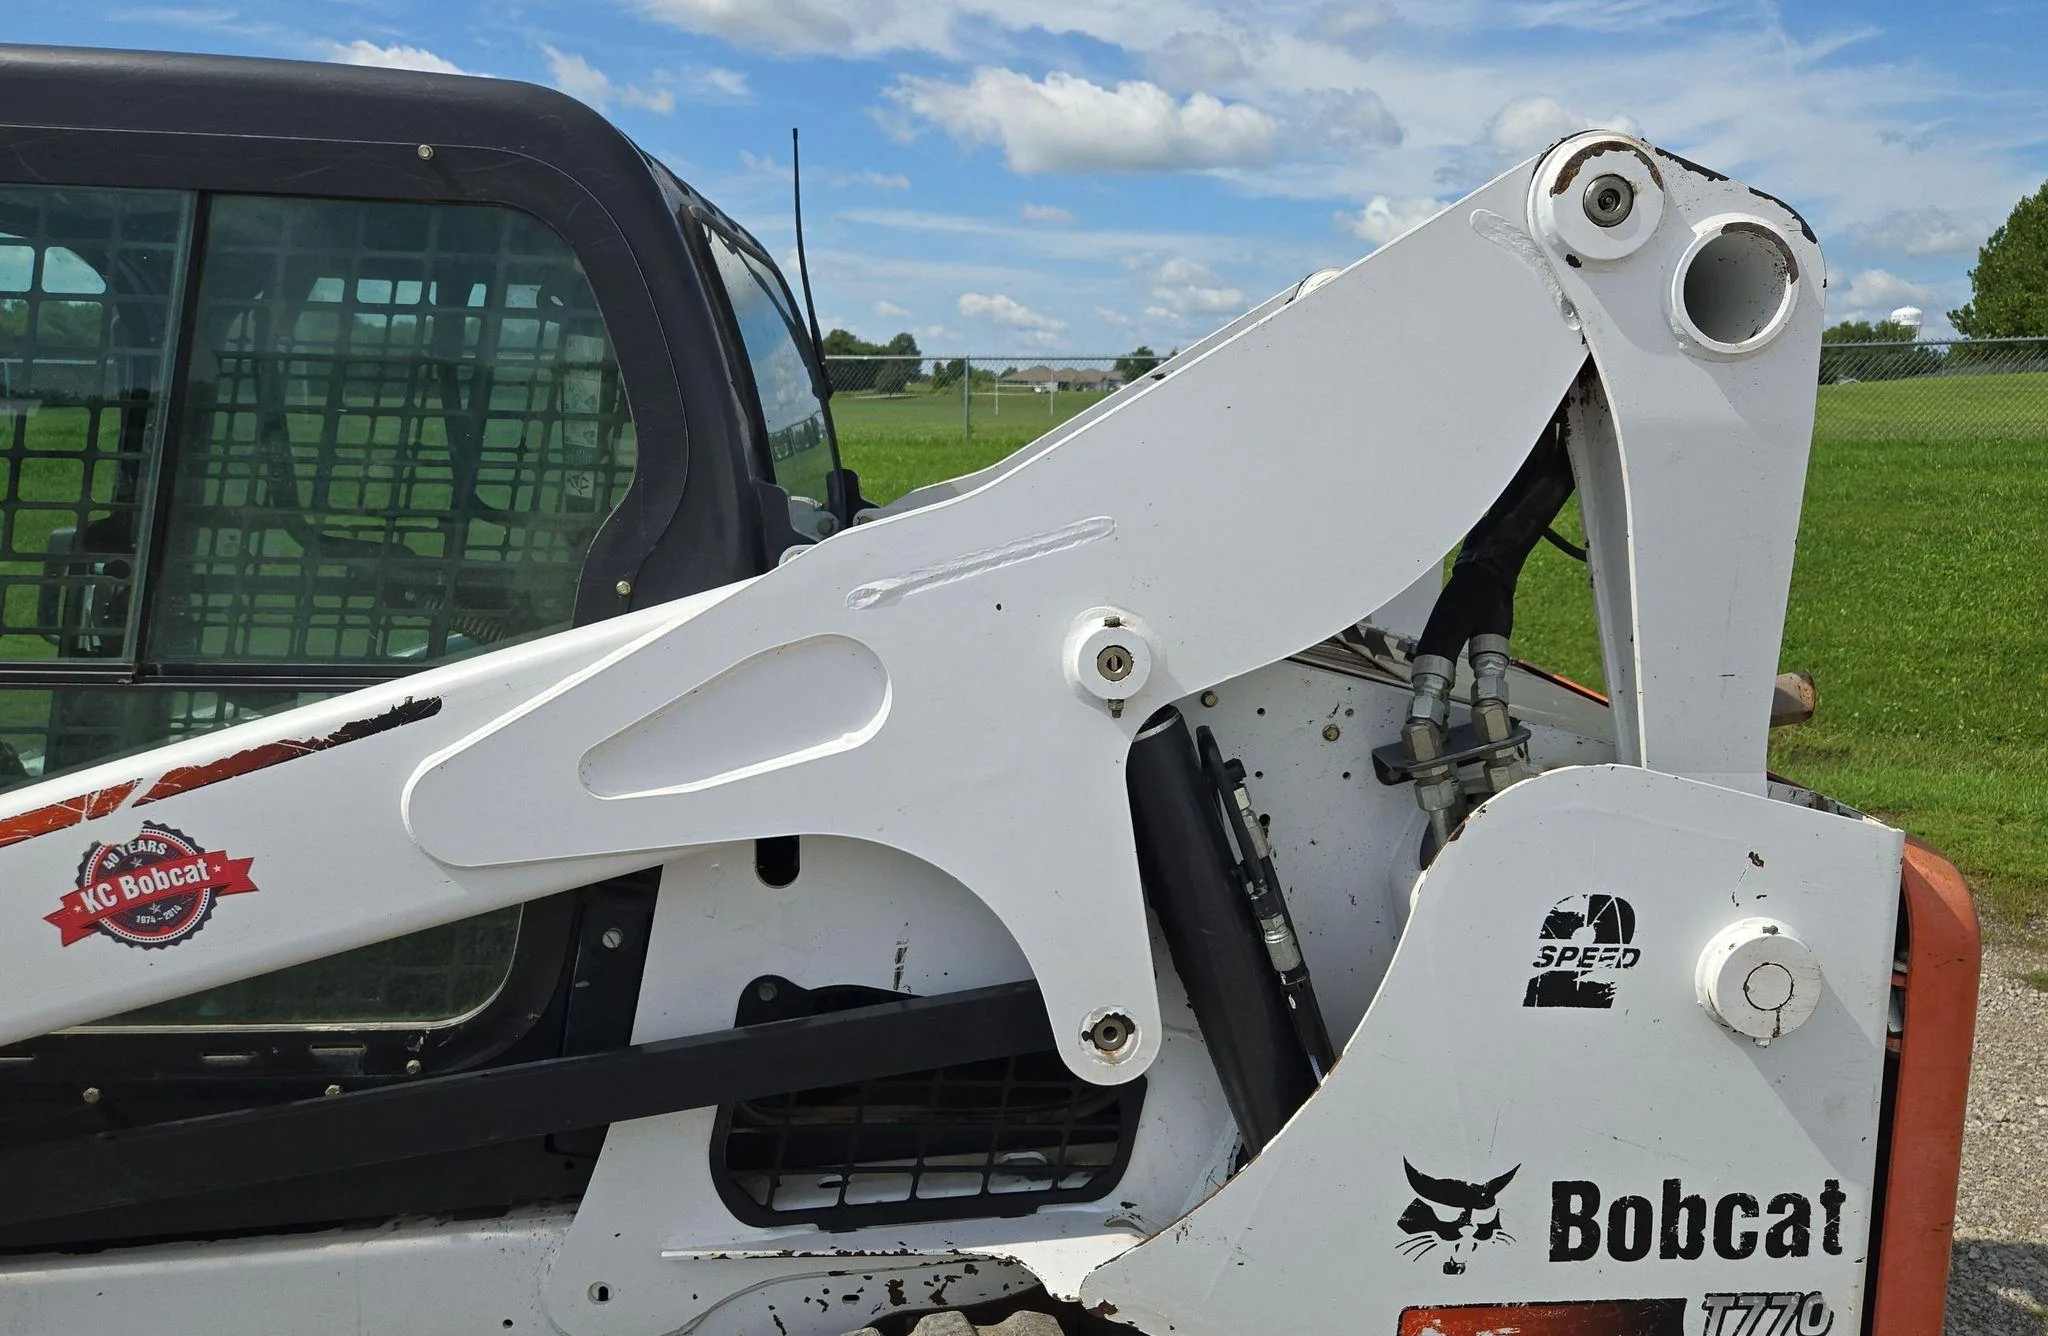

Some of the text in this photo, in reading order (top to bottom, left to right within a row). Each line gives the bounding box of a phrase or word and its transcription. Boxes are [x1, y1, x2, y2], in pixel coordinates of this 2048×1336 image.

[102, 840, 168, 870] 40 YEARS
[80, 858, 210, 914] KC Bobcat
[1532, 945, 1642, 969] SPEED
[1548, 1178, 1847, 1263] Bobcat
[1701, 1291, 1835, 1336] T770
